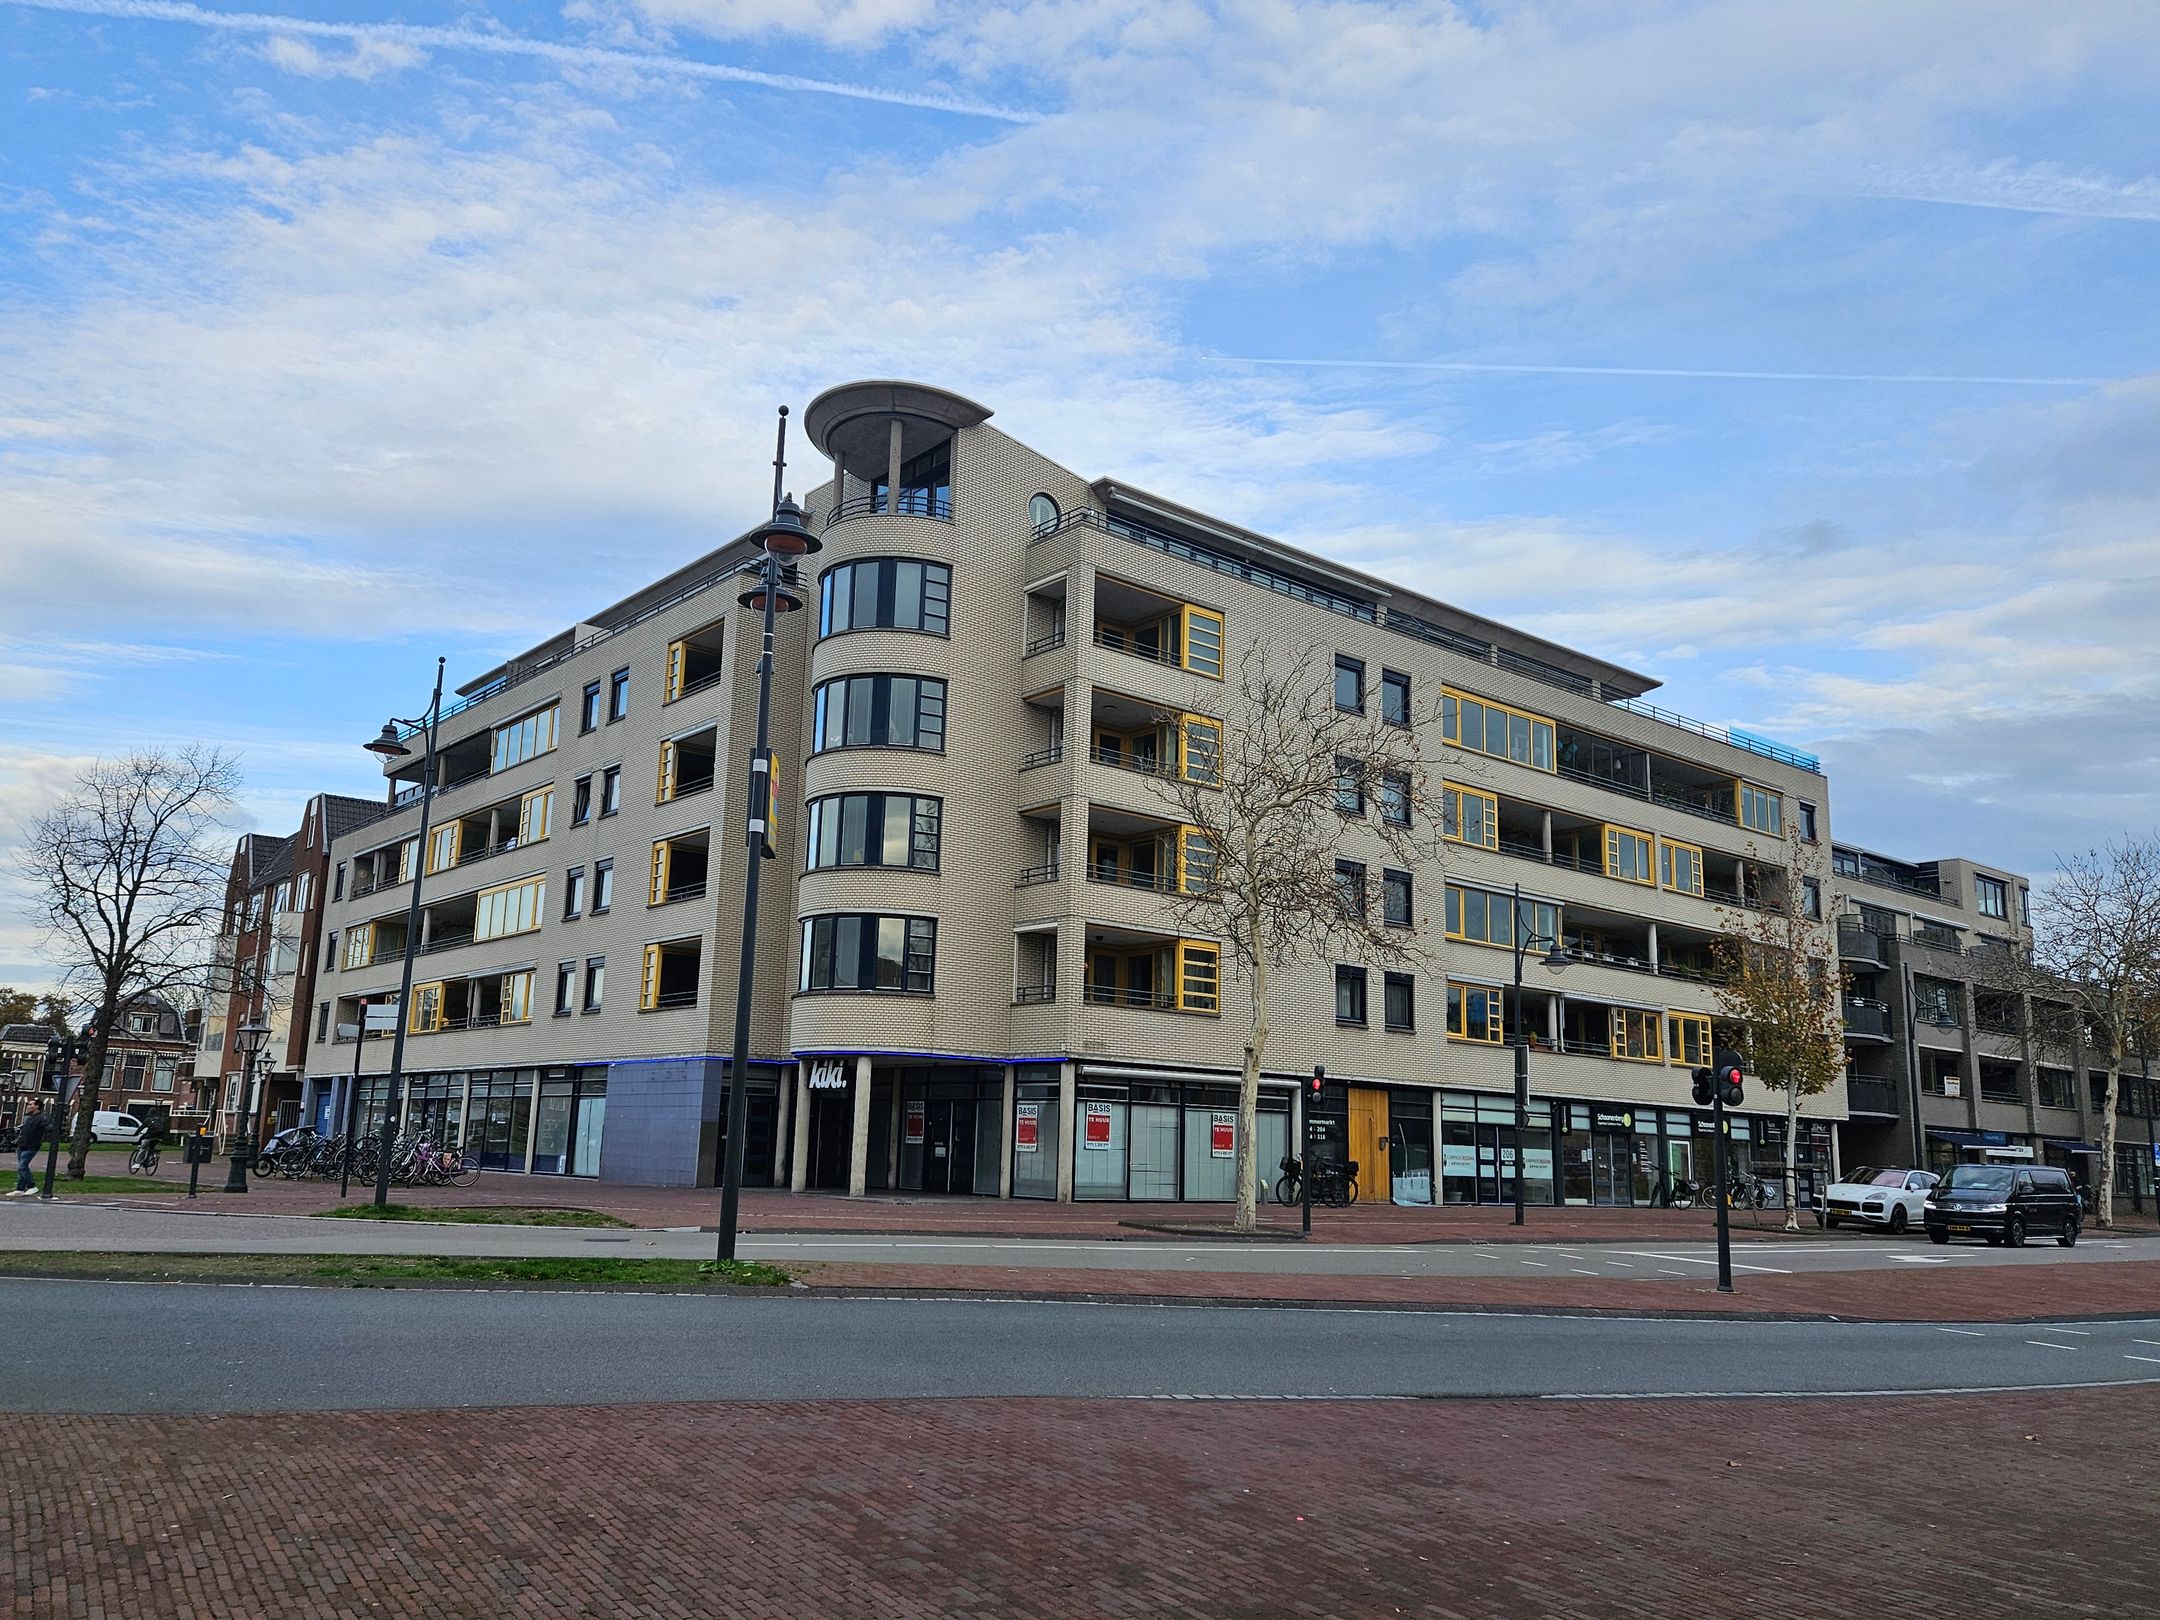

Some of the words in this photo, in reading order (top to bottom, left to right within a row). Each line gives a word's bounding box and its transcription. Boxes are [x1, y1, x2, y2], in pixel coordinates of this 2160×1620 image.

[1018, 1106, 1037, 1115] BASIS
[1088, 1103, 1111, 1113] BASIS
[1213, 1114, 1234, 1123] BASIS
[1502, 1149, 1514, 1159] 206
